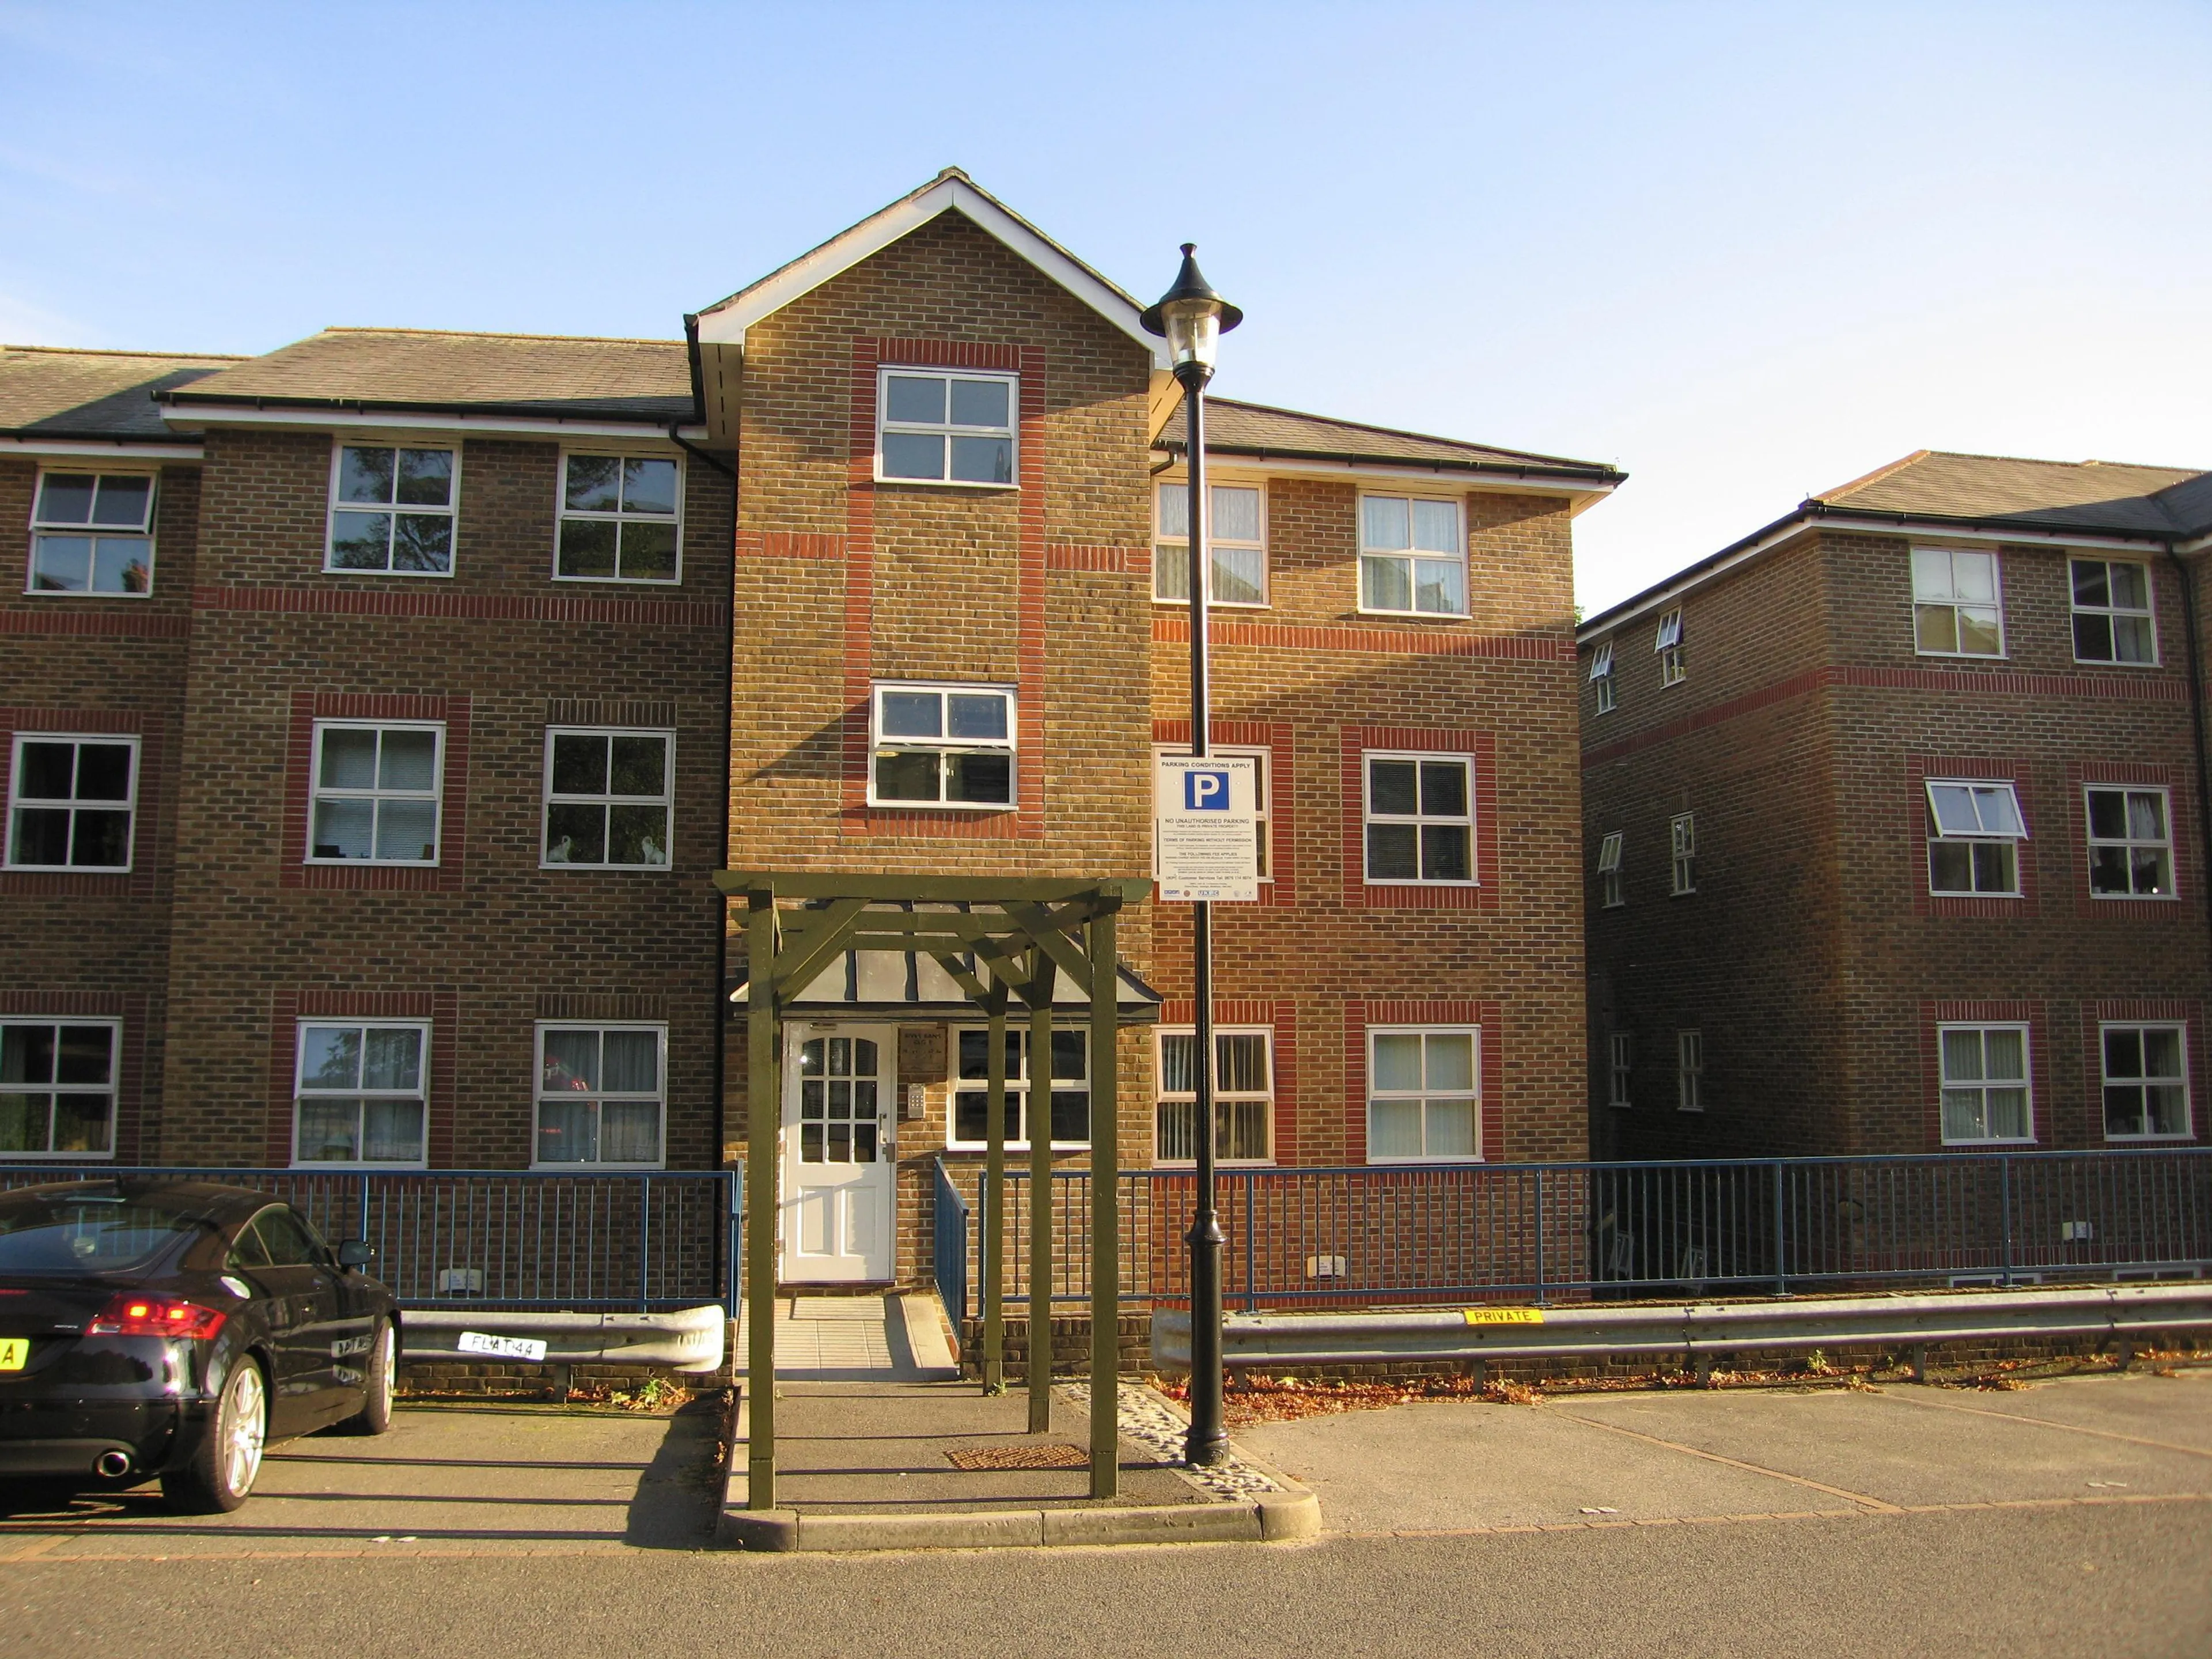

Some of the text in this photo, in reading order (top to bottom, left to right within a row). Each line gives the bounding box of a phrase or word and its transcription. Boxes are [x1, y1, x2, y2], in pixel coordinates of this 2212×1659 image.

[1194, 775, 1219, 807] P
[1474, 1311, 1532, 1322] PRIVATE
[472, 1336, 533, 1355] FLAT 44
